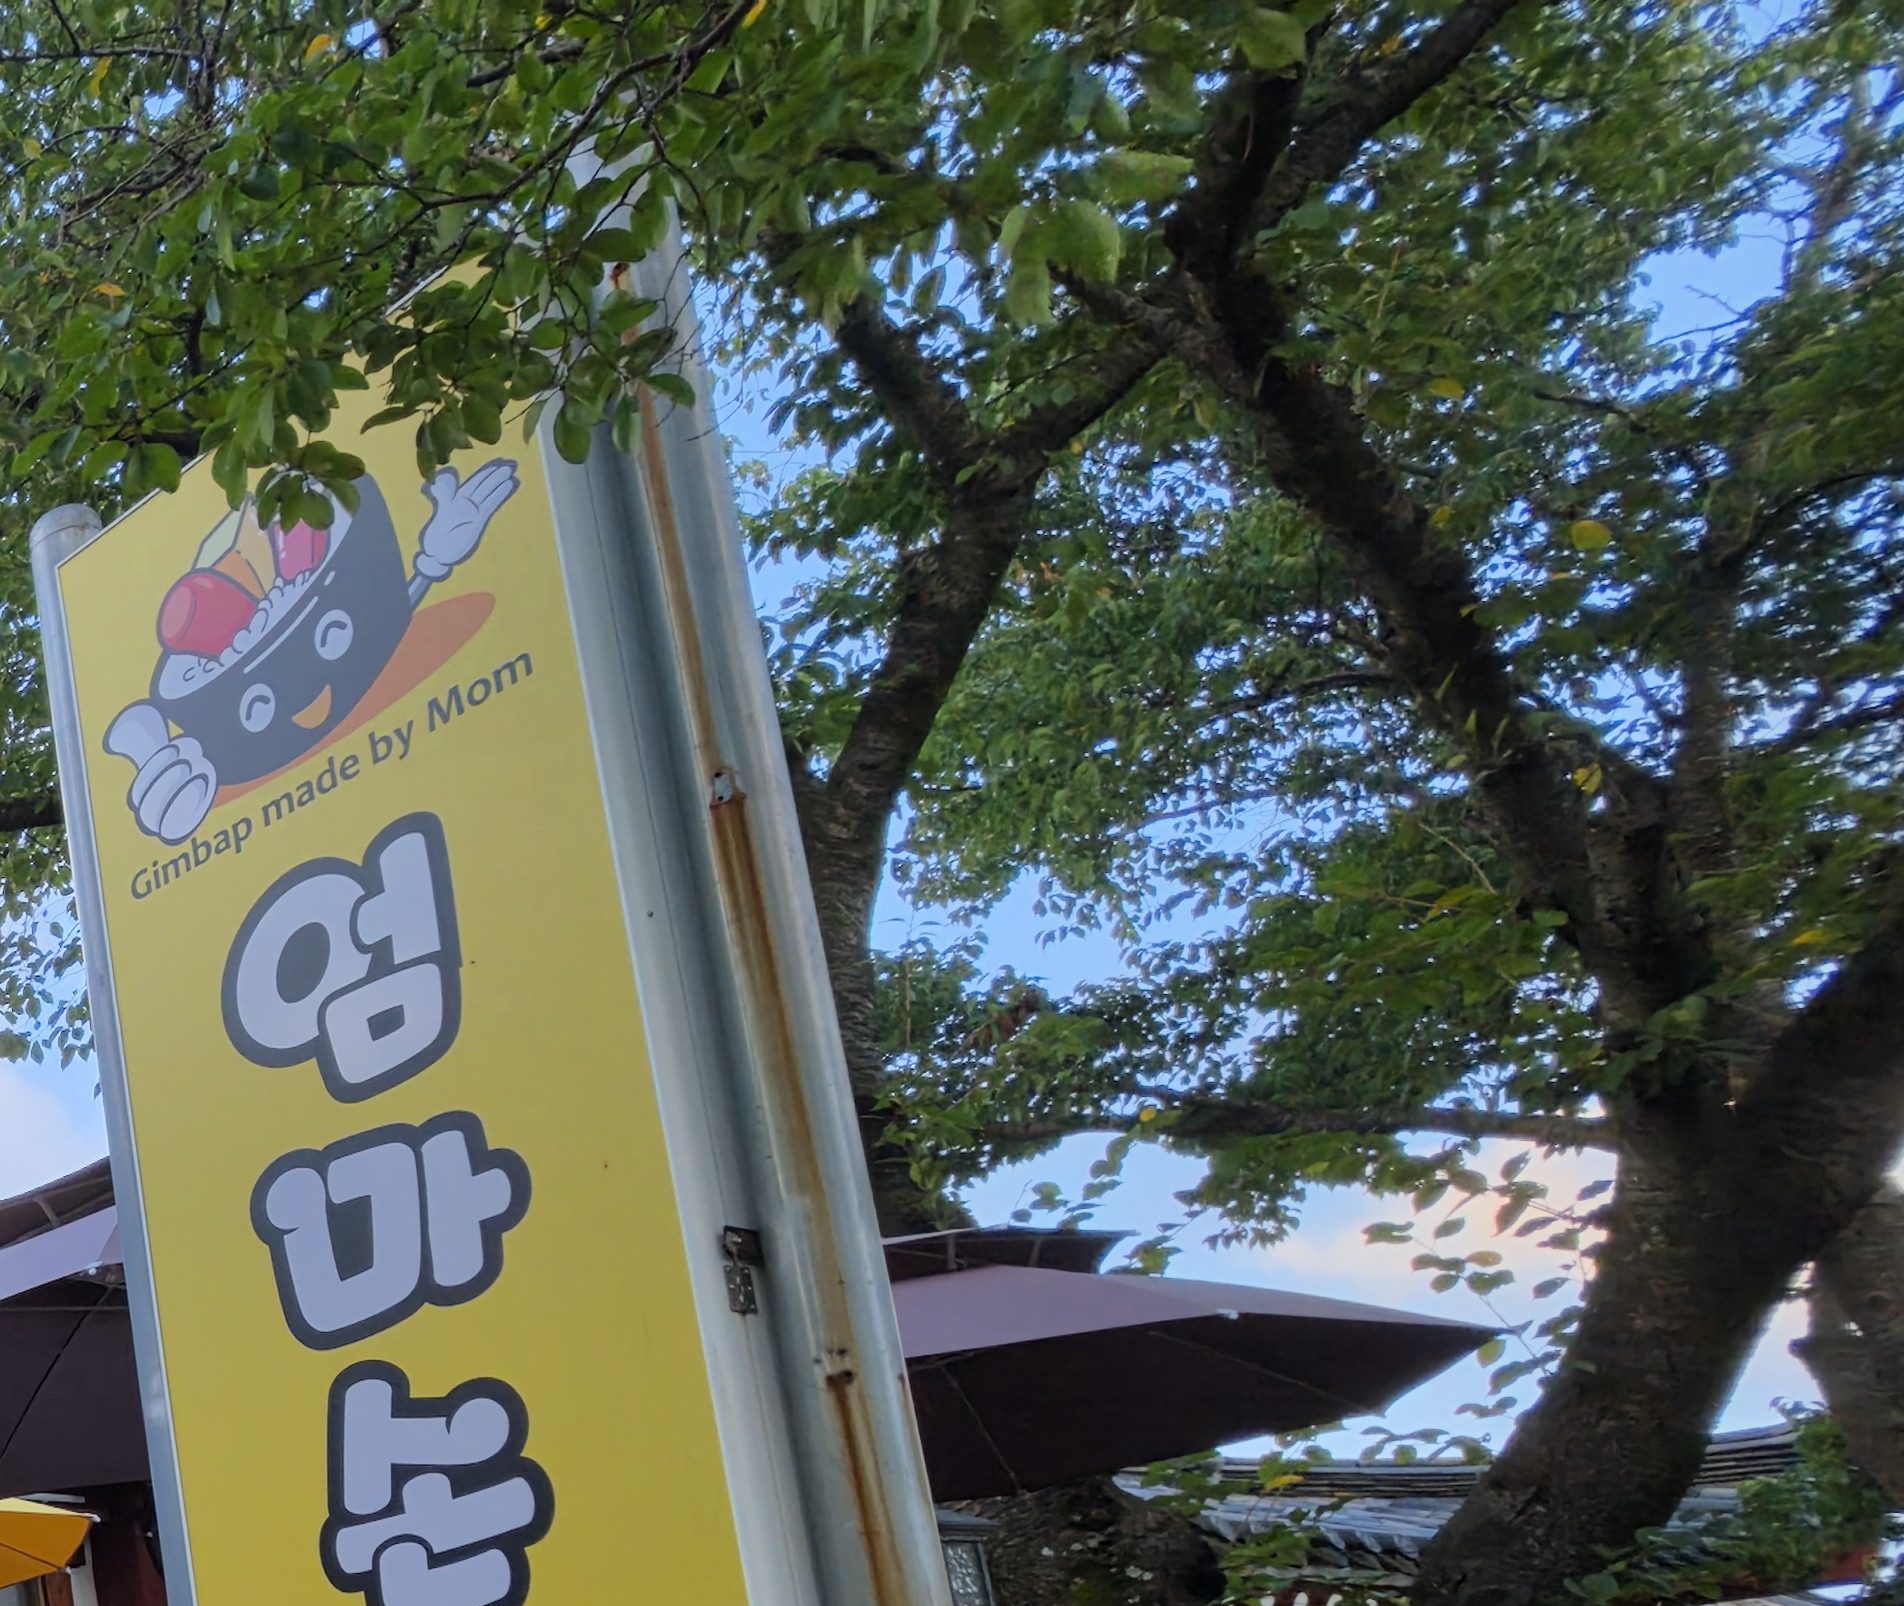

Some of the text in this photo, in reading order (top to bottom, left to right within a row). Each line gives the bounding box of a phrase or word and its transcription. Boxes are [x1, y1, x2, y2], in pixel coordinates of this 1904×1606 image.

[131, 652, 534, 900] Gimbap made by Mom
